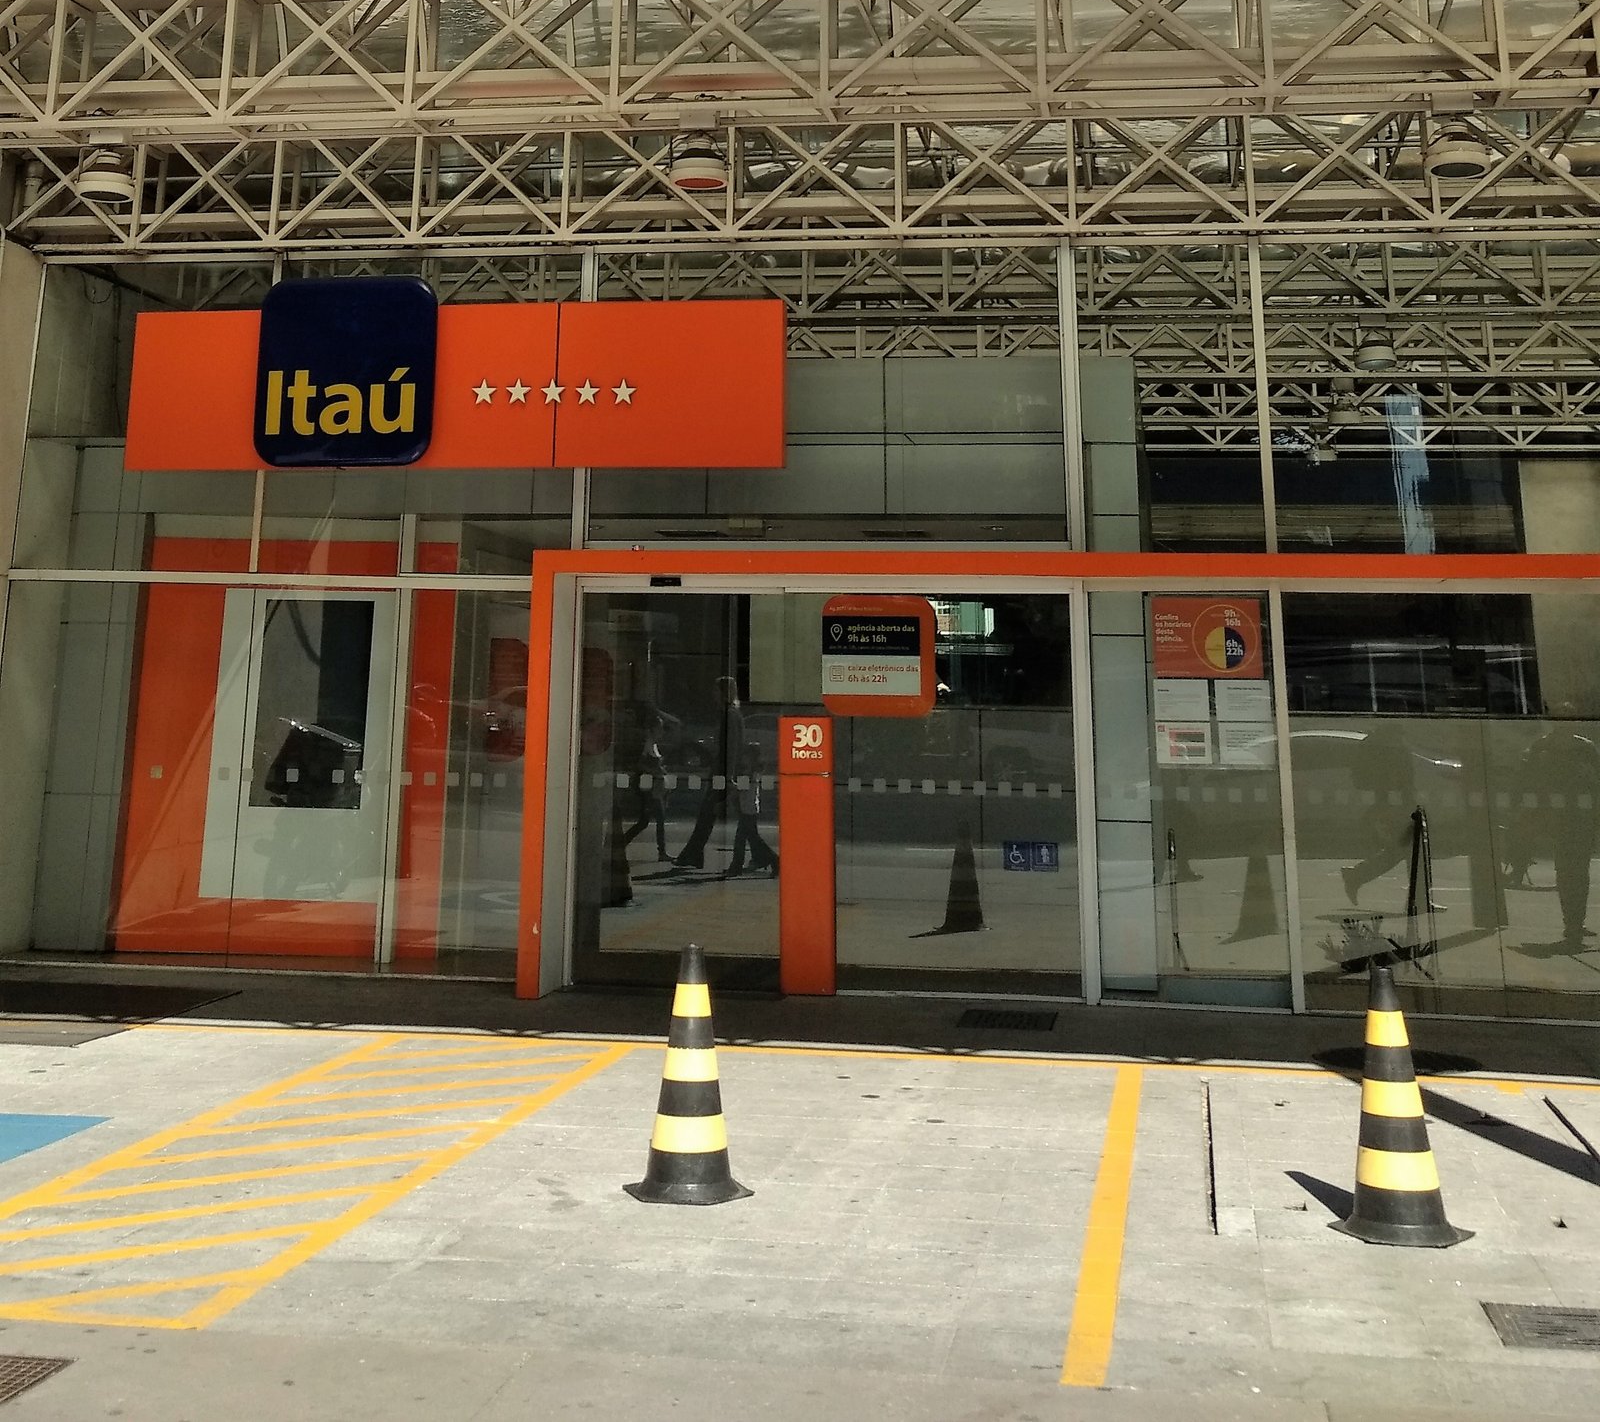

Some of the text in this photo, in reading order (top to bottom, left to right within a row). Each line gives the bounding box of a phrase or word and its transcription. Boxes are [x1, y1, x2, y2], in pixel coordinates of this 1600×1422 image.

[264, 366, 416, 436] Itaú
[1154, 613, 1179, 621] Confira
[1224, 609, 1236, 617] 9h
[1224, 617, 1241, 626] 16h
[847, 623, 915, 633] agência aberta das
[847, 634, 887, 643] 9h às 16h
[1226, 639, 1238, 648] 6h
[1226, 647, 1244, 656] 22h
[847, 664, 867, 672] caixa
[867, 664, 905, 672] eletrônico
[847, 674, 859, 683] 6h
[871, 674, 888, 683] 22h
[792, 724, 823, 748] 30
[791, 748, 823, 759] horas
